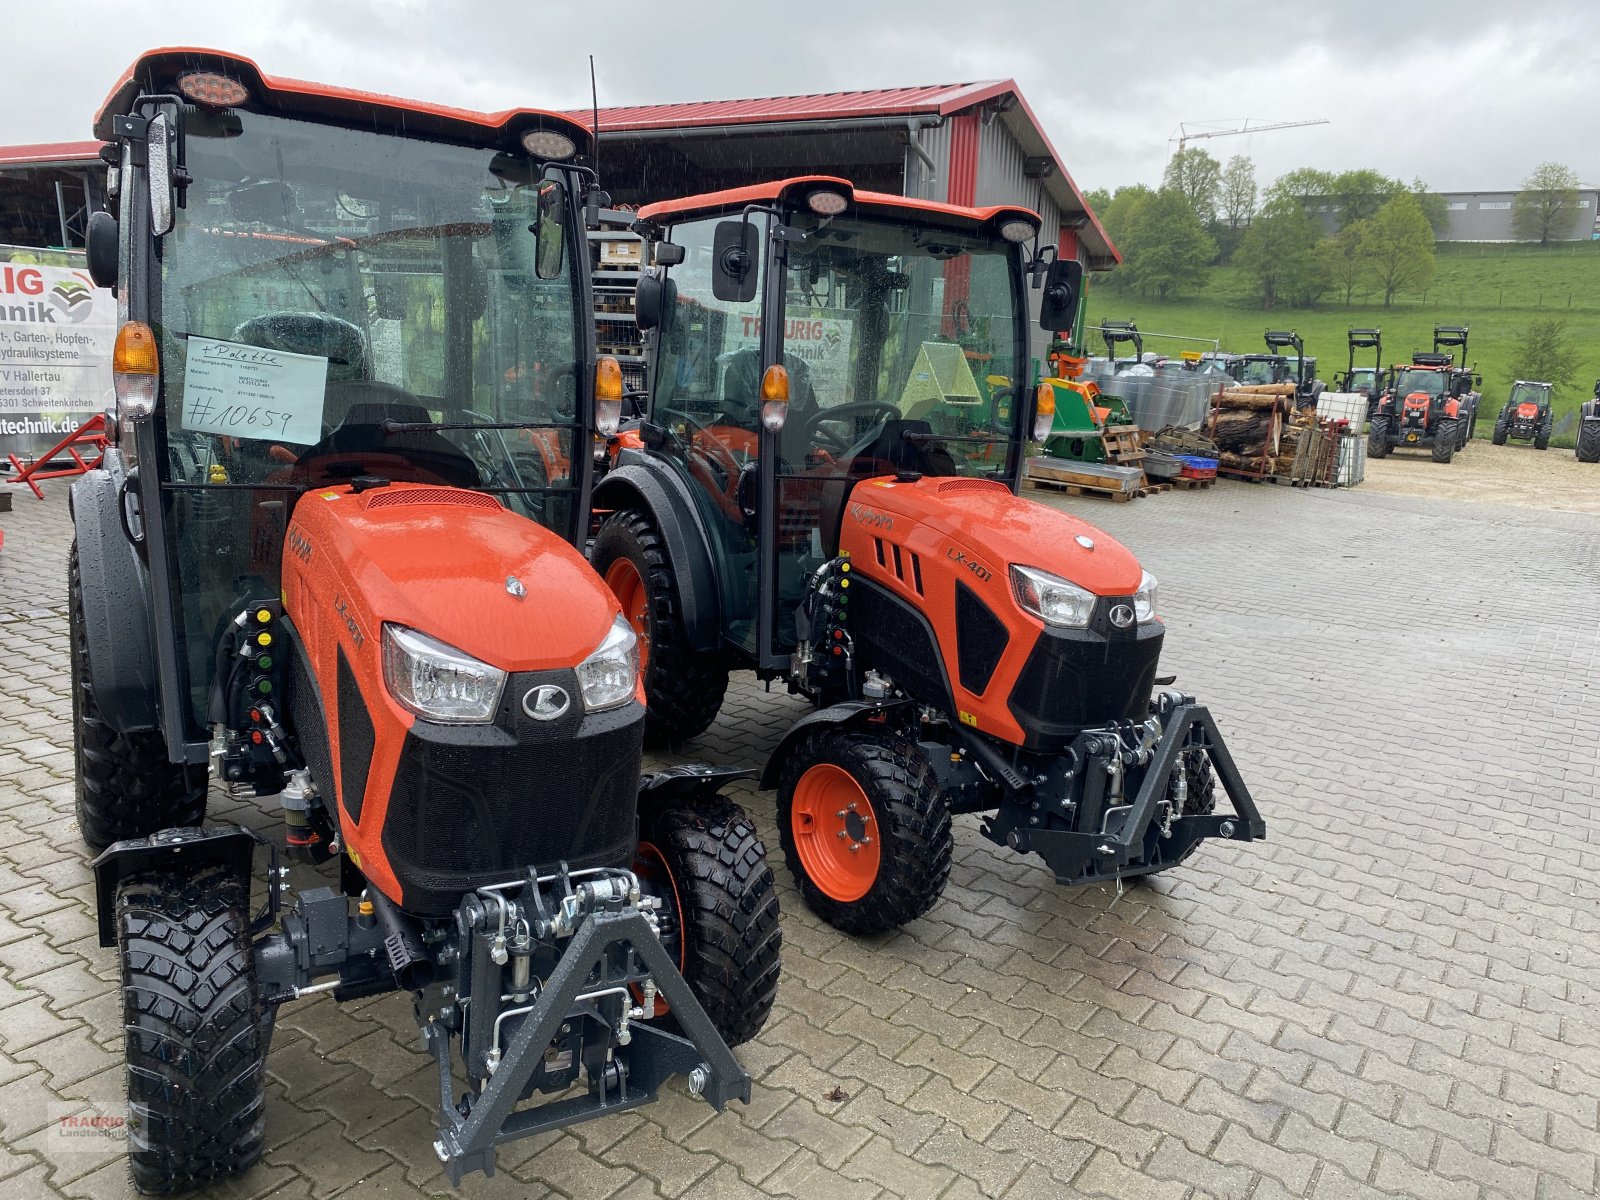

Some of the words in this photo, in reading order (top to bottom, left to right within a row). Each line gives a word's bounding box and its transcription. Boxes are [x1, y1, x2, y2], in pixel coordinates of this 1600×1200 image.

[0, 266, 44, 295] IG
[741, 316, 823, 340] TRURIG
[14, 331, 53, 345] Garten-,
[55, 333, 95, 346] Hopfen-,
[0, 347, 79, 361] ydrauliksysteme
[215, 345, 277, 364] Palette
[0, 370, 10, 381] V
[14, 370, 60, 382] Hallertau
[40, 386, 51, 396] 37
[22, 398, 94, 408] Schweitenkirchen
[0, 416, 79, 435] technik.de
[188, 396, 292, 436] #10659
[947, 547, 992, 582] LX-401
